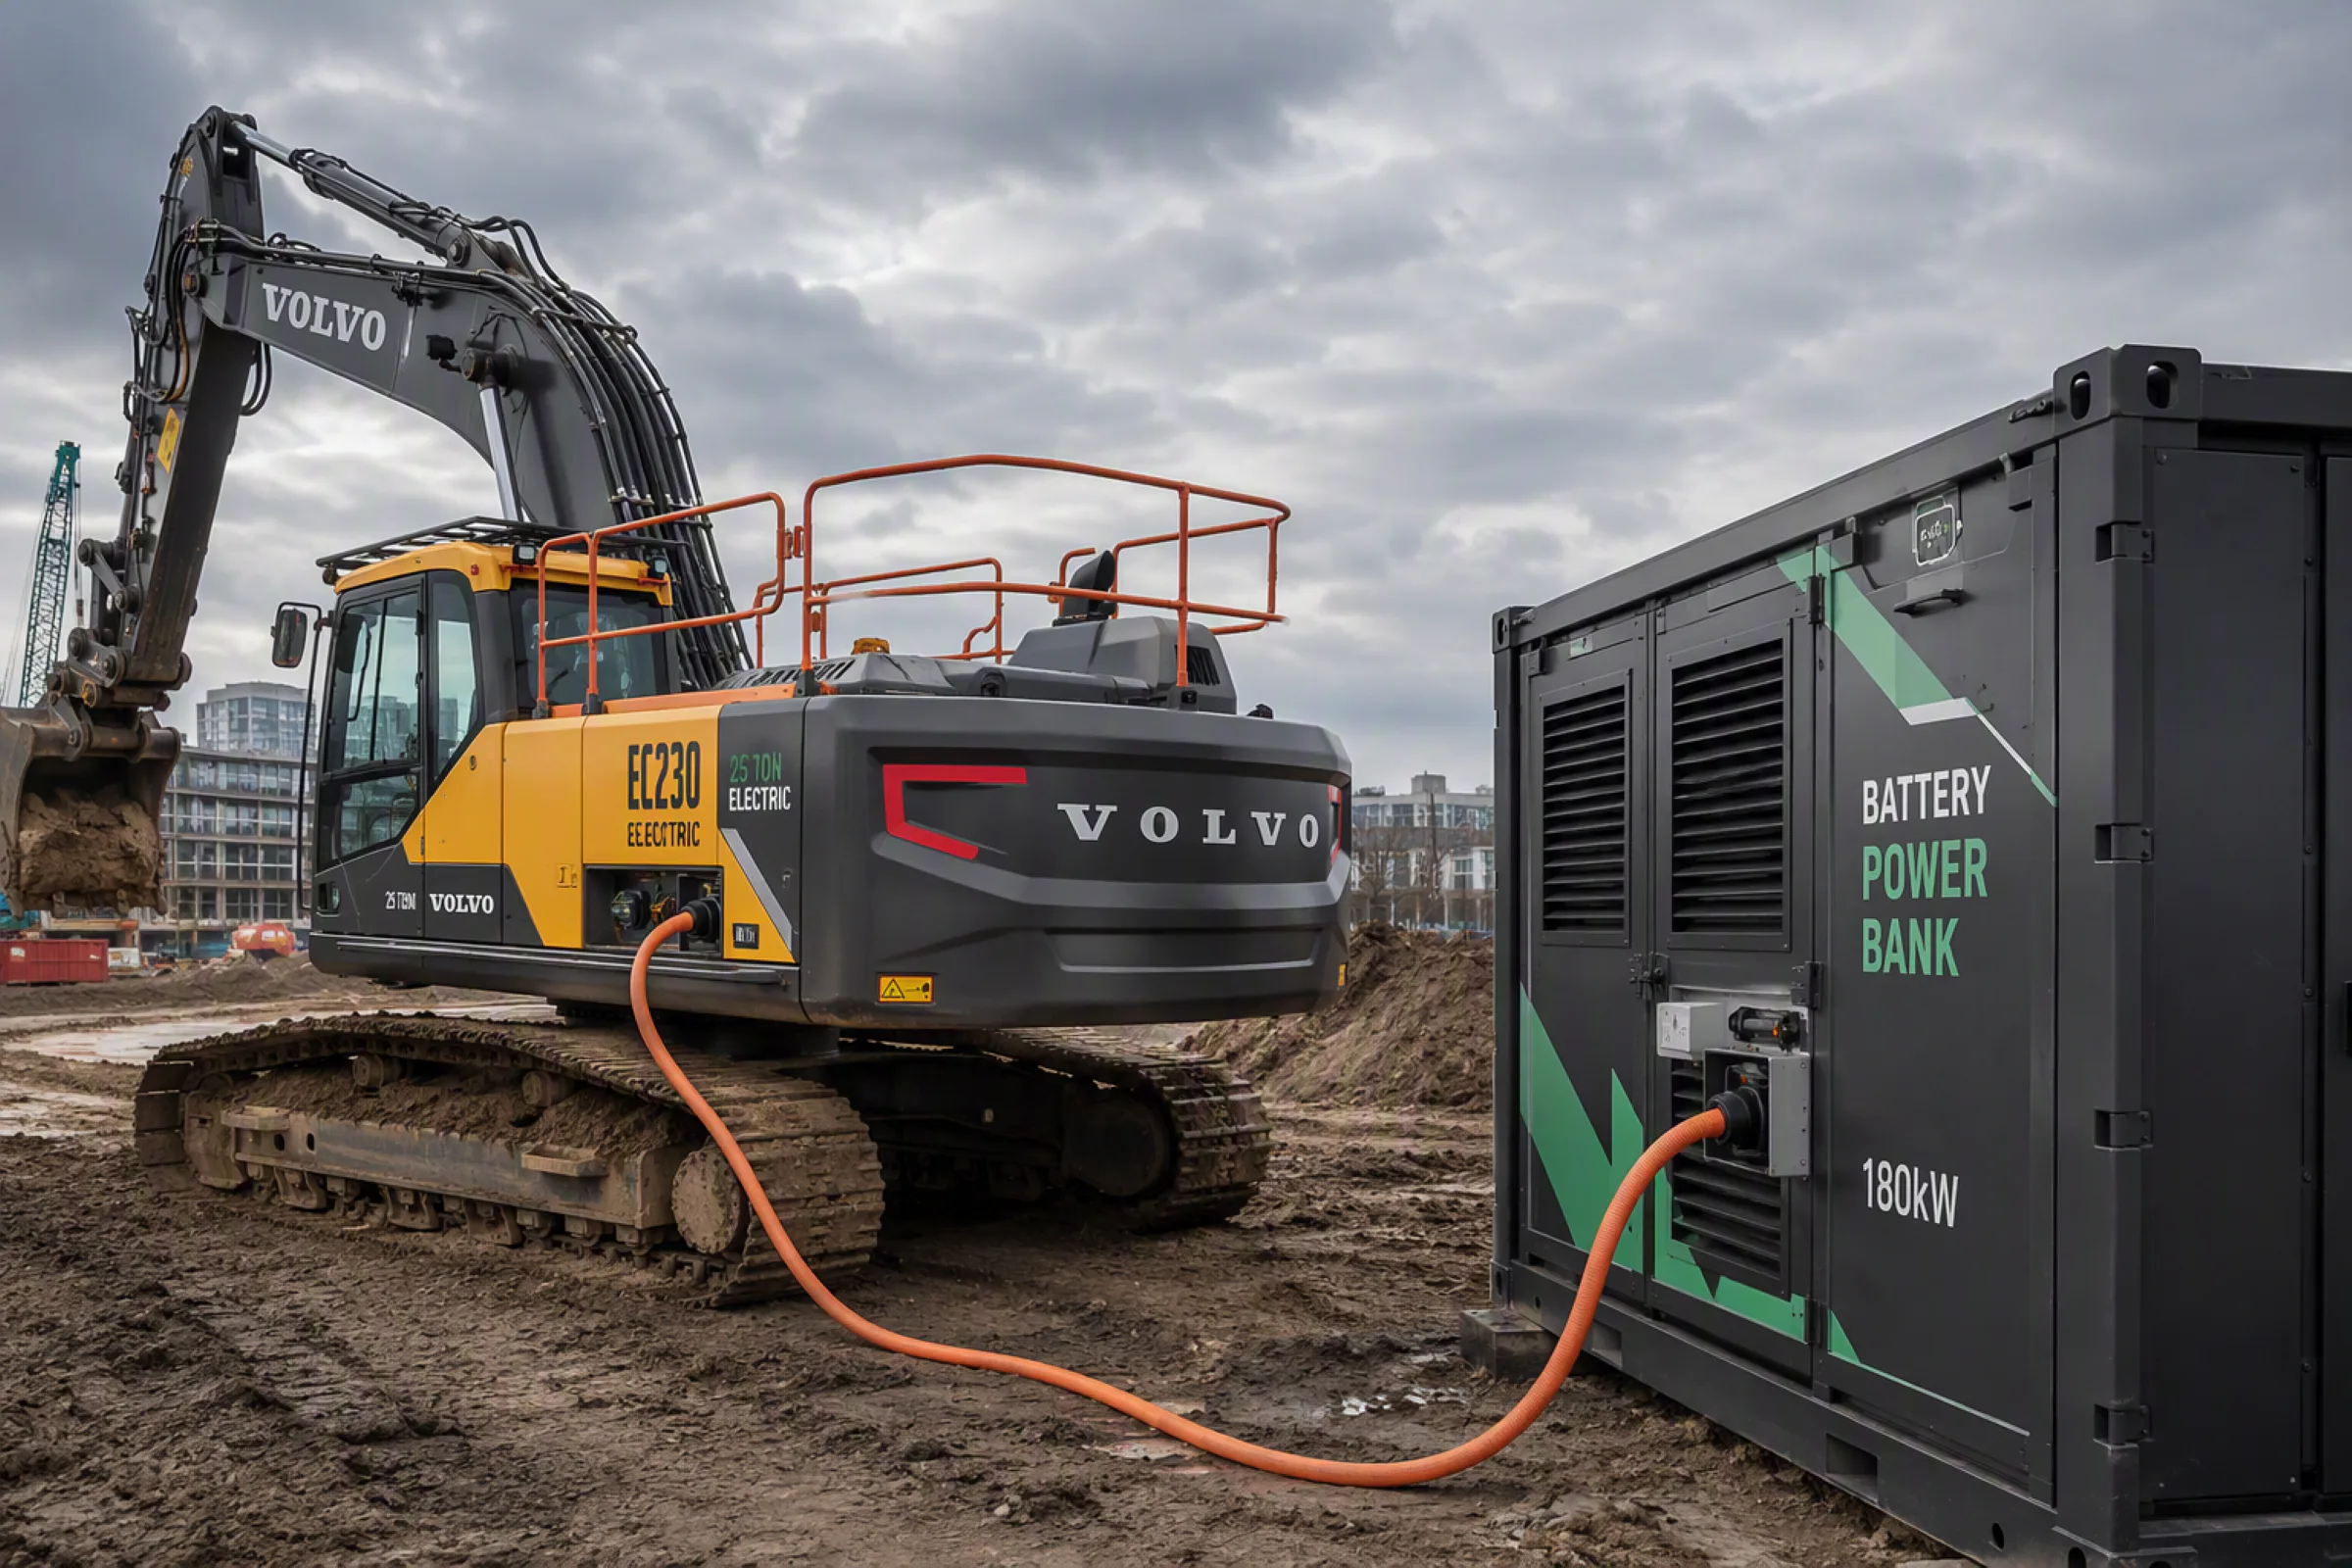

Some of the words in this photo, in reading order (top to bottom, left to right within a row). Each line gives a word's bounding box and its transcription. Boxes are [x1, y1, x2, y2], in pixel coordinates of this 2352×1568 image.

[263, 282, 386, 351] VOLVO
[627, 741, 701, 810] EC230
[729, 755, 749, 783] 25
[753, 752, 782, 782] TON
[1863, 764, 1991, 824] BATTERY
[729, 786, 792, 811] ELECTRIC
[1057, 803, 1319, 849] VOLVO
[1863, 838, 1988, 900] POWER
[429, 893, 495, 914] VOLVO
[1863, 917, 1959, 976] BANK
[1863, 1157, 1959, 1228] 180kW
